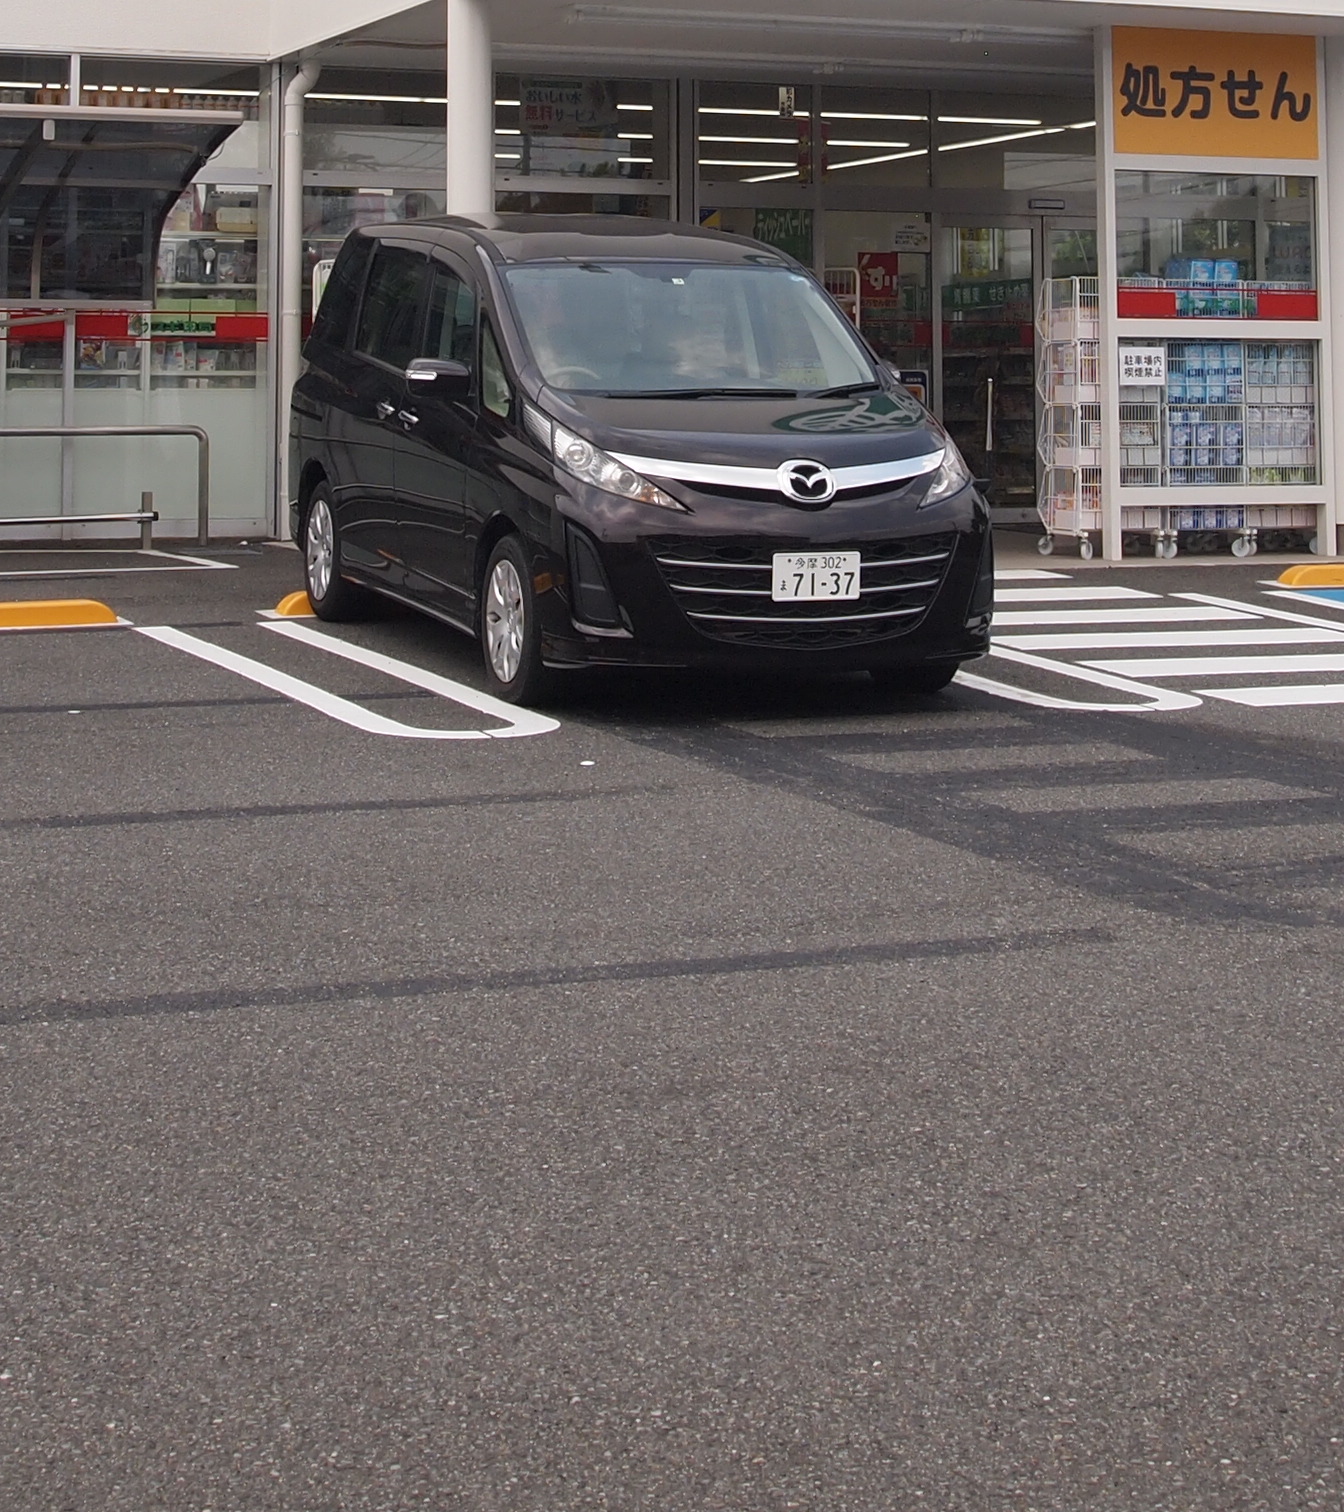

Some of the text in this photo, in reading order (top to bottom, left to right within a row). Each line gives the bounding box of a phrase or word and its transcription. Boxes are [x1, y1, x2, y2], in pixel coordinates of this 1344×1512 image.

[525, 90, 583, 104] おいしい水
[1119, 62, 1312, 122] 処方せん
[1124, 355, 1163, 366] 駐車場内
[1124, 367, 1163, 378] 喫煙禁止
[795, 556, 842, 570] 多摩 302
[792, 571, 856, 597] 71-37
